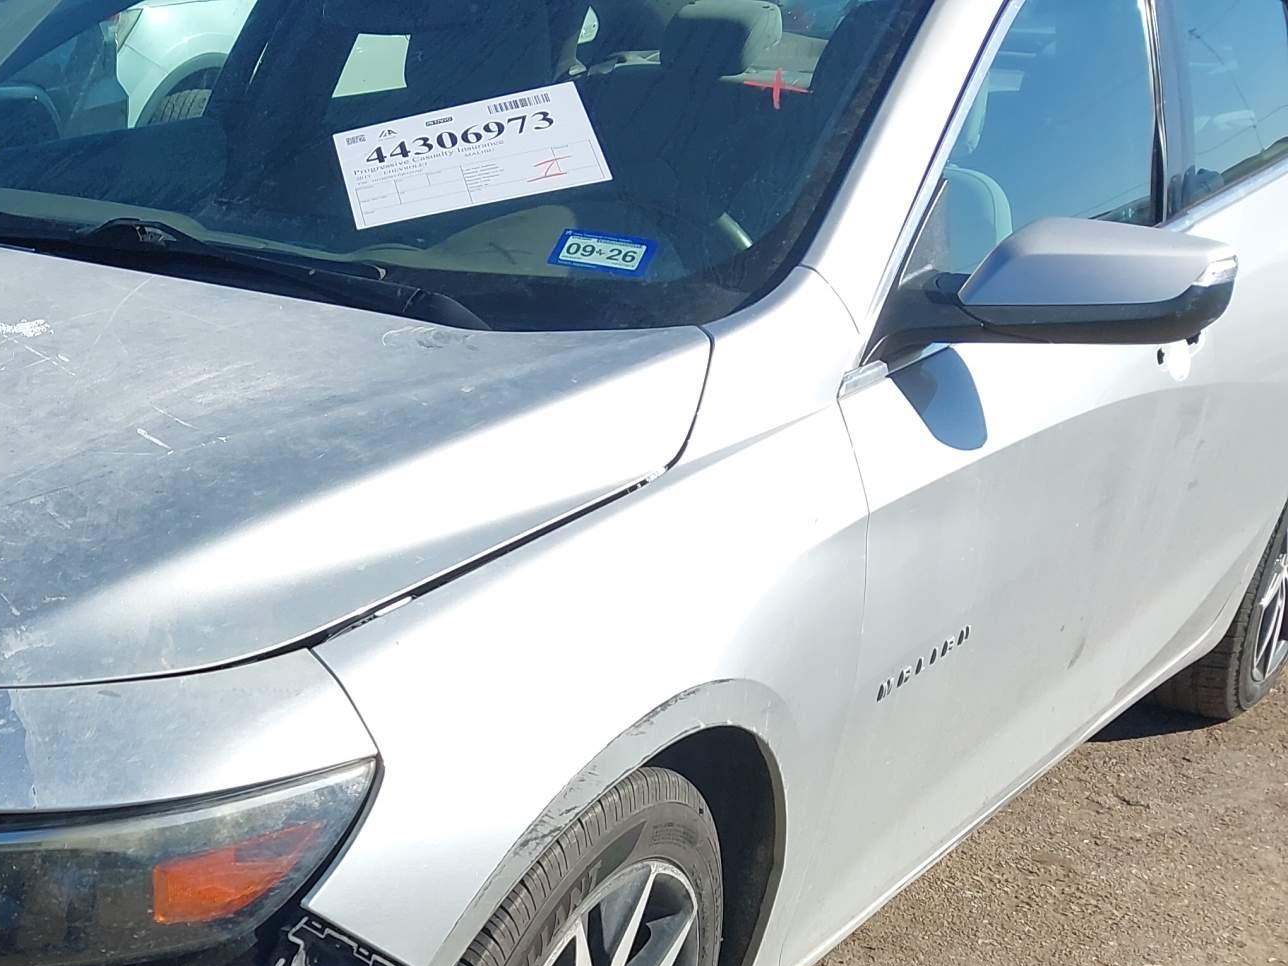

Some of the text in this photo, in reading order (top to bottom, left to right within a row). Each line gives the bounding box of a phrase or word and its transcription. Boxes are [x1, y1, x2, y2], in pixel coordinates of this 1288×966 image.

[366, 111, 554, 164] 44306973
[353, 140, 504, 175] Progressive Casualty Insurance
[566, 242, 596, 258] 09
[606, 247, 638, 264] 26
